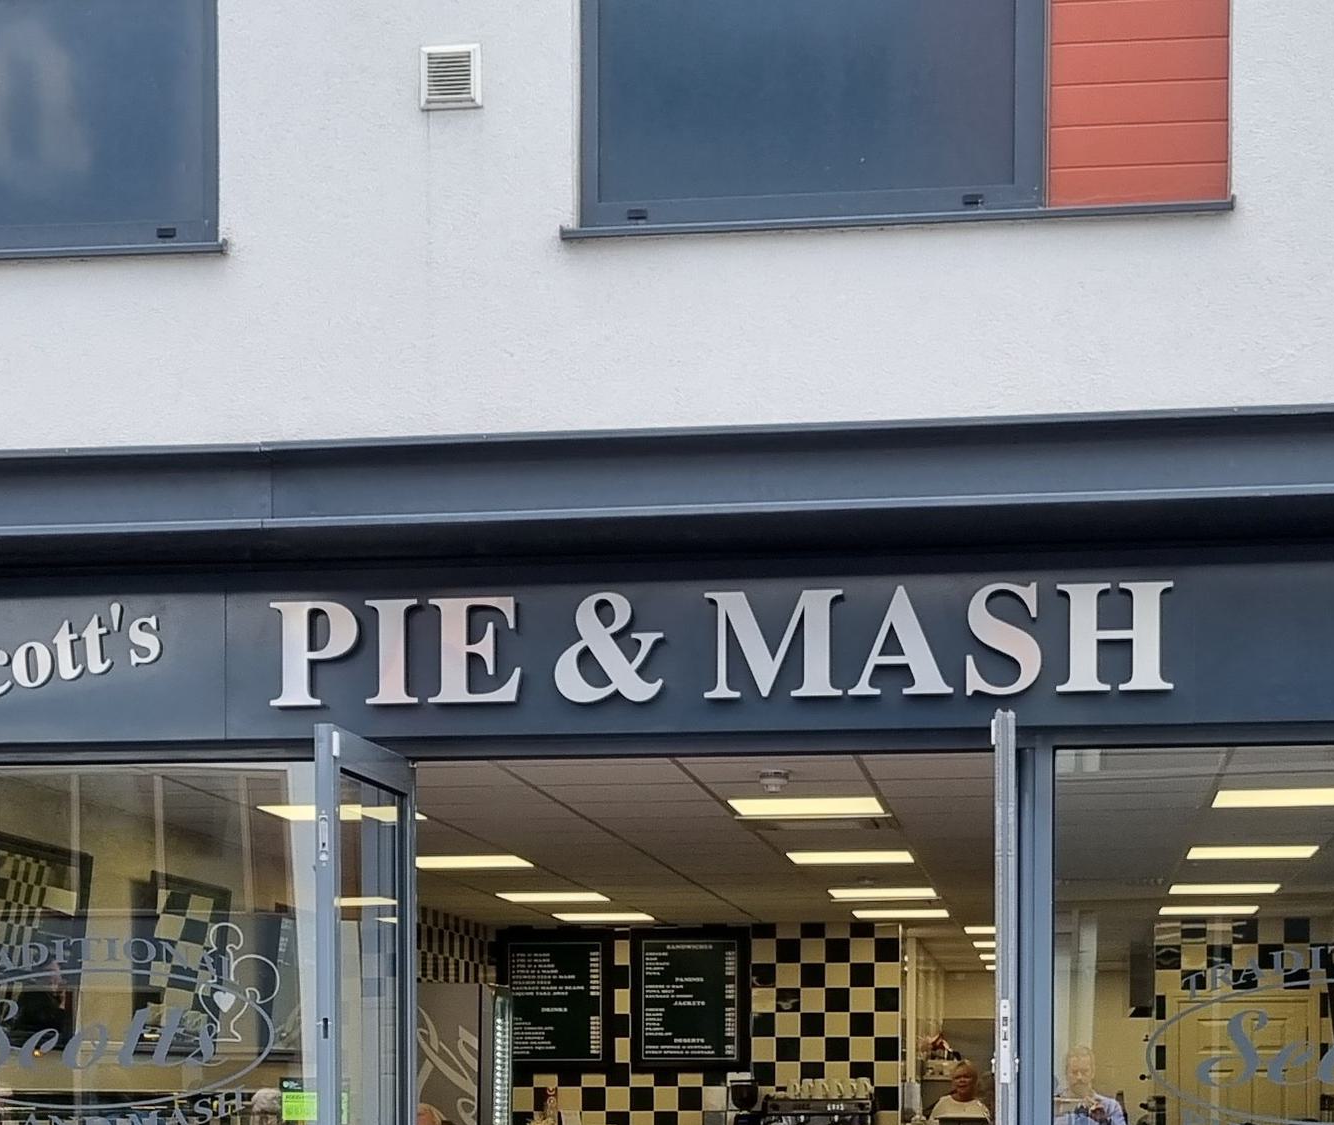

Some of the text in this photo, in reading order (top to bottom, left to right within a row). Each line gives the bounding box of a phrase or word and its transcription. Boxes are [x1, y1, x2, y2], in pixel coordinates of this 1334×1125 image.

[269, 580, 1175, 707] PIE & MASH
